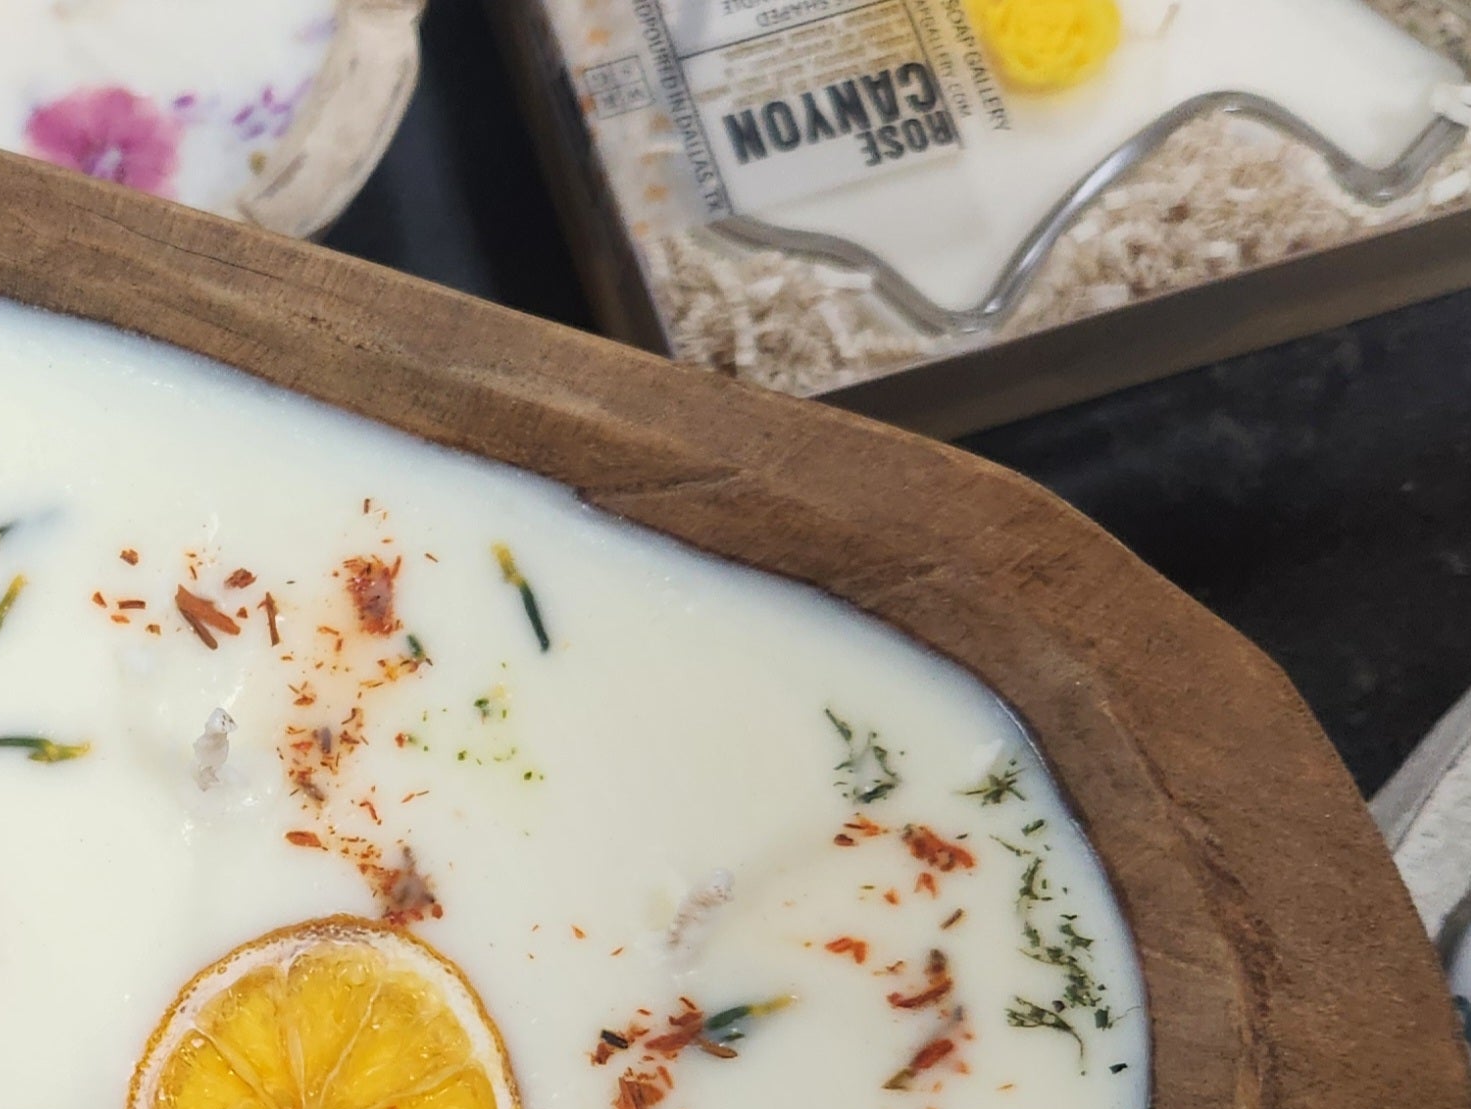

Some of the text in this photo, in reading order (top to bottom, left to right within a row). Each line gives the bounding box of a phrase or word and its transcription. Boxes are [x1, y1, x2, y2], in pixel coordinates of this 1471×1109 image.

[666, 90, 687, 113] IN
[722, 62, 937, 165] CANYON
[962, 50, 1012, 131] GALLERY
[855, 110, 955, 167] ROSE
